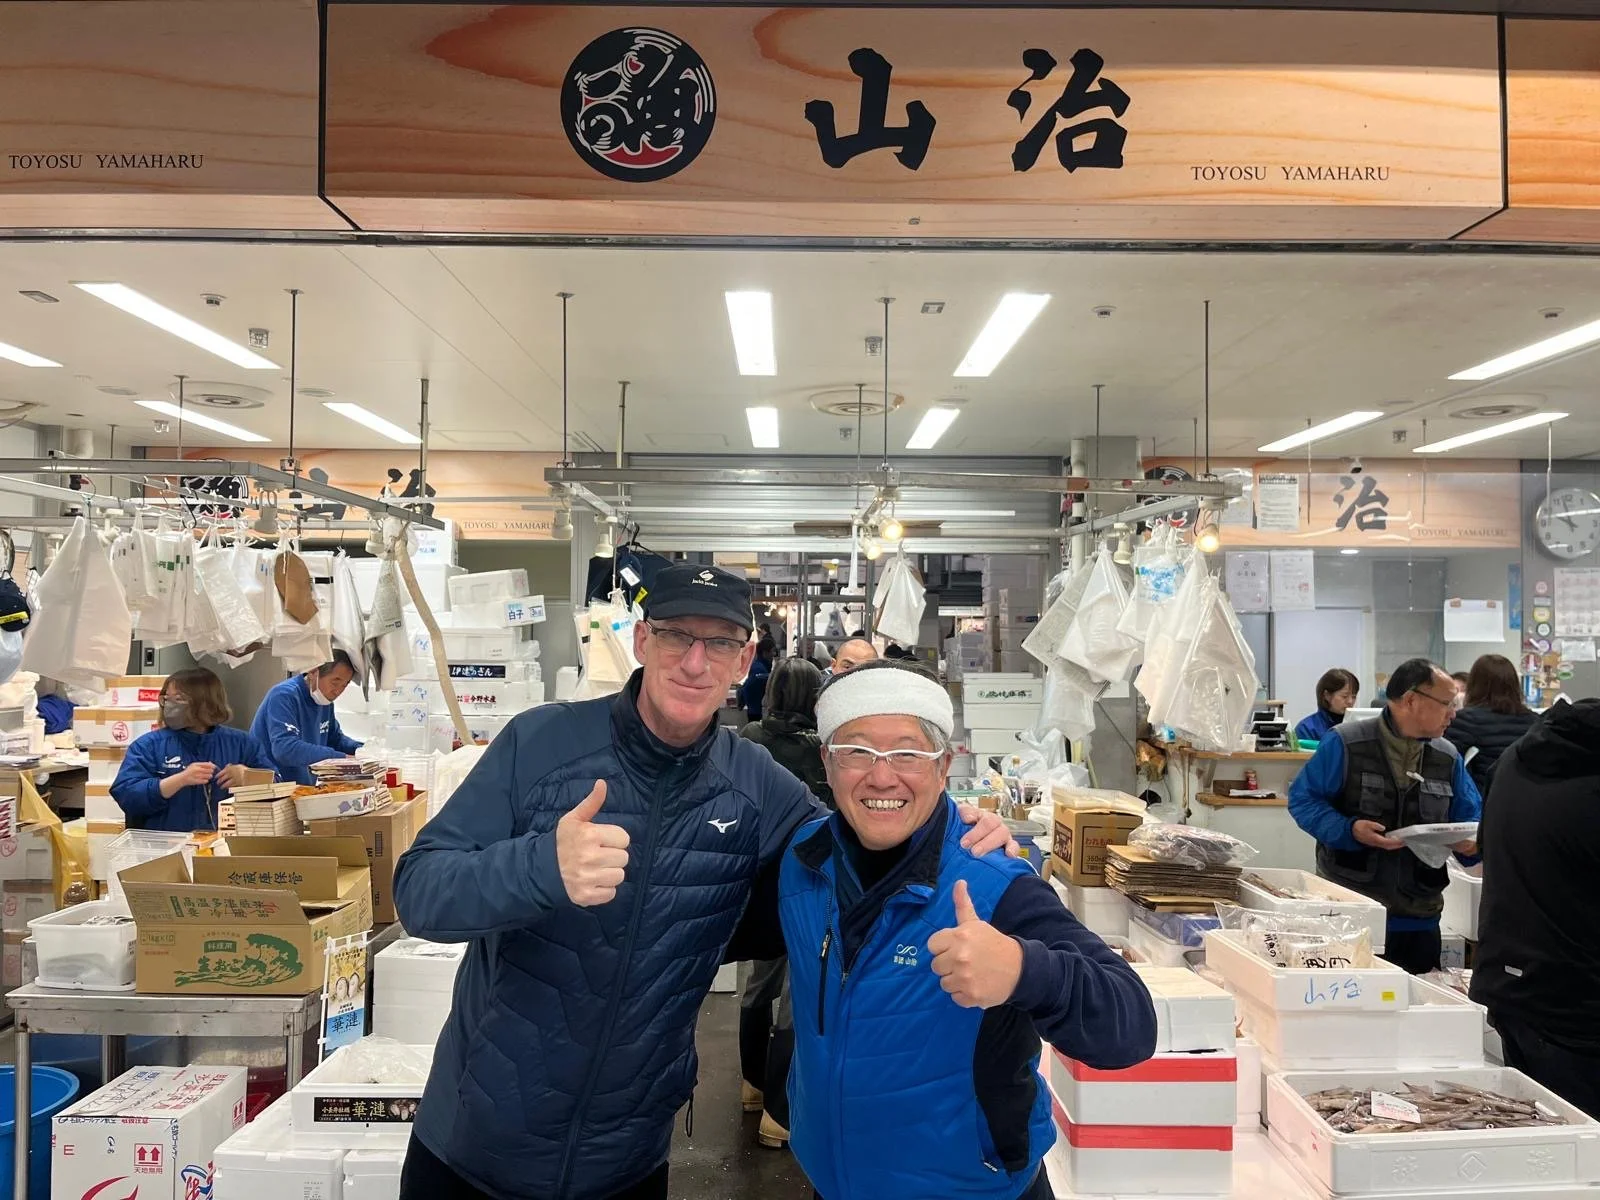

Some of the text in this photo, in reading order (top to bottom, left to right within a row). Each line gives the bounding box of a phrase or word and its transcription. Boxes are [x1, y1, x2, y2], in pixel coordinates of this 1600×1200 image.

[805, 47, 1132, 173] 山治
[8, 152, 204, 170] TOYOSU YAMAHARU
[1190, 164, 1391, 182] TOYOSU YAMAHARU
[504, 519, 554, 530] YAMAHARU
[508, 609, 525, 620] 白子
[63, 1143, 75, 1156] E
